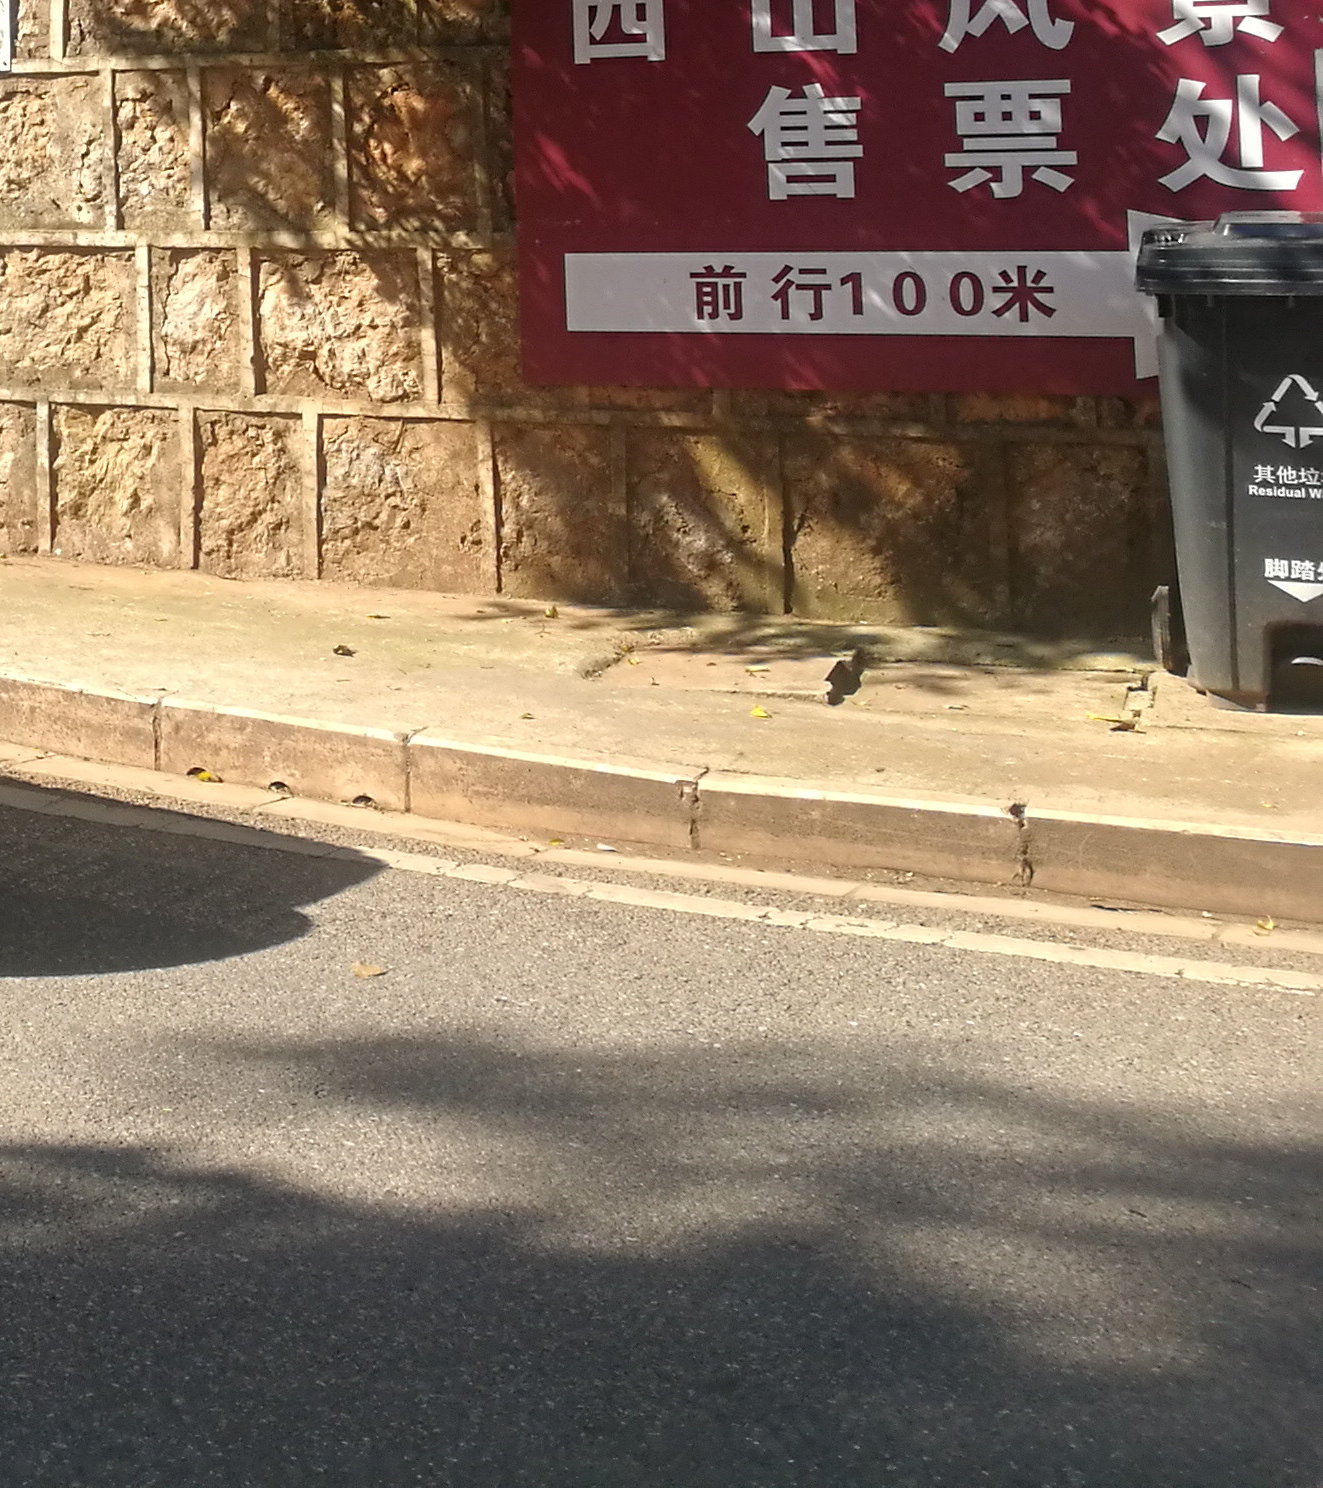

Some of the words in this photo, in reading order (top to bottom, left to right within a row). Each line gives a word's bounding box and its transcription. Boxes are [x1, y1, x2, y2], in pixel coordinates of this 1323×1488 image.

[747, 74, 1304, 201] 售票处
[689, 264, 1057, 323] 前行100米
[1248, 485, 1306, 499] Residual
[1308, 488, 1323, 499] W
[1253, 464, 1323, 486] 其他垃
